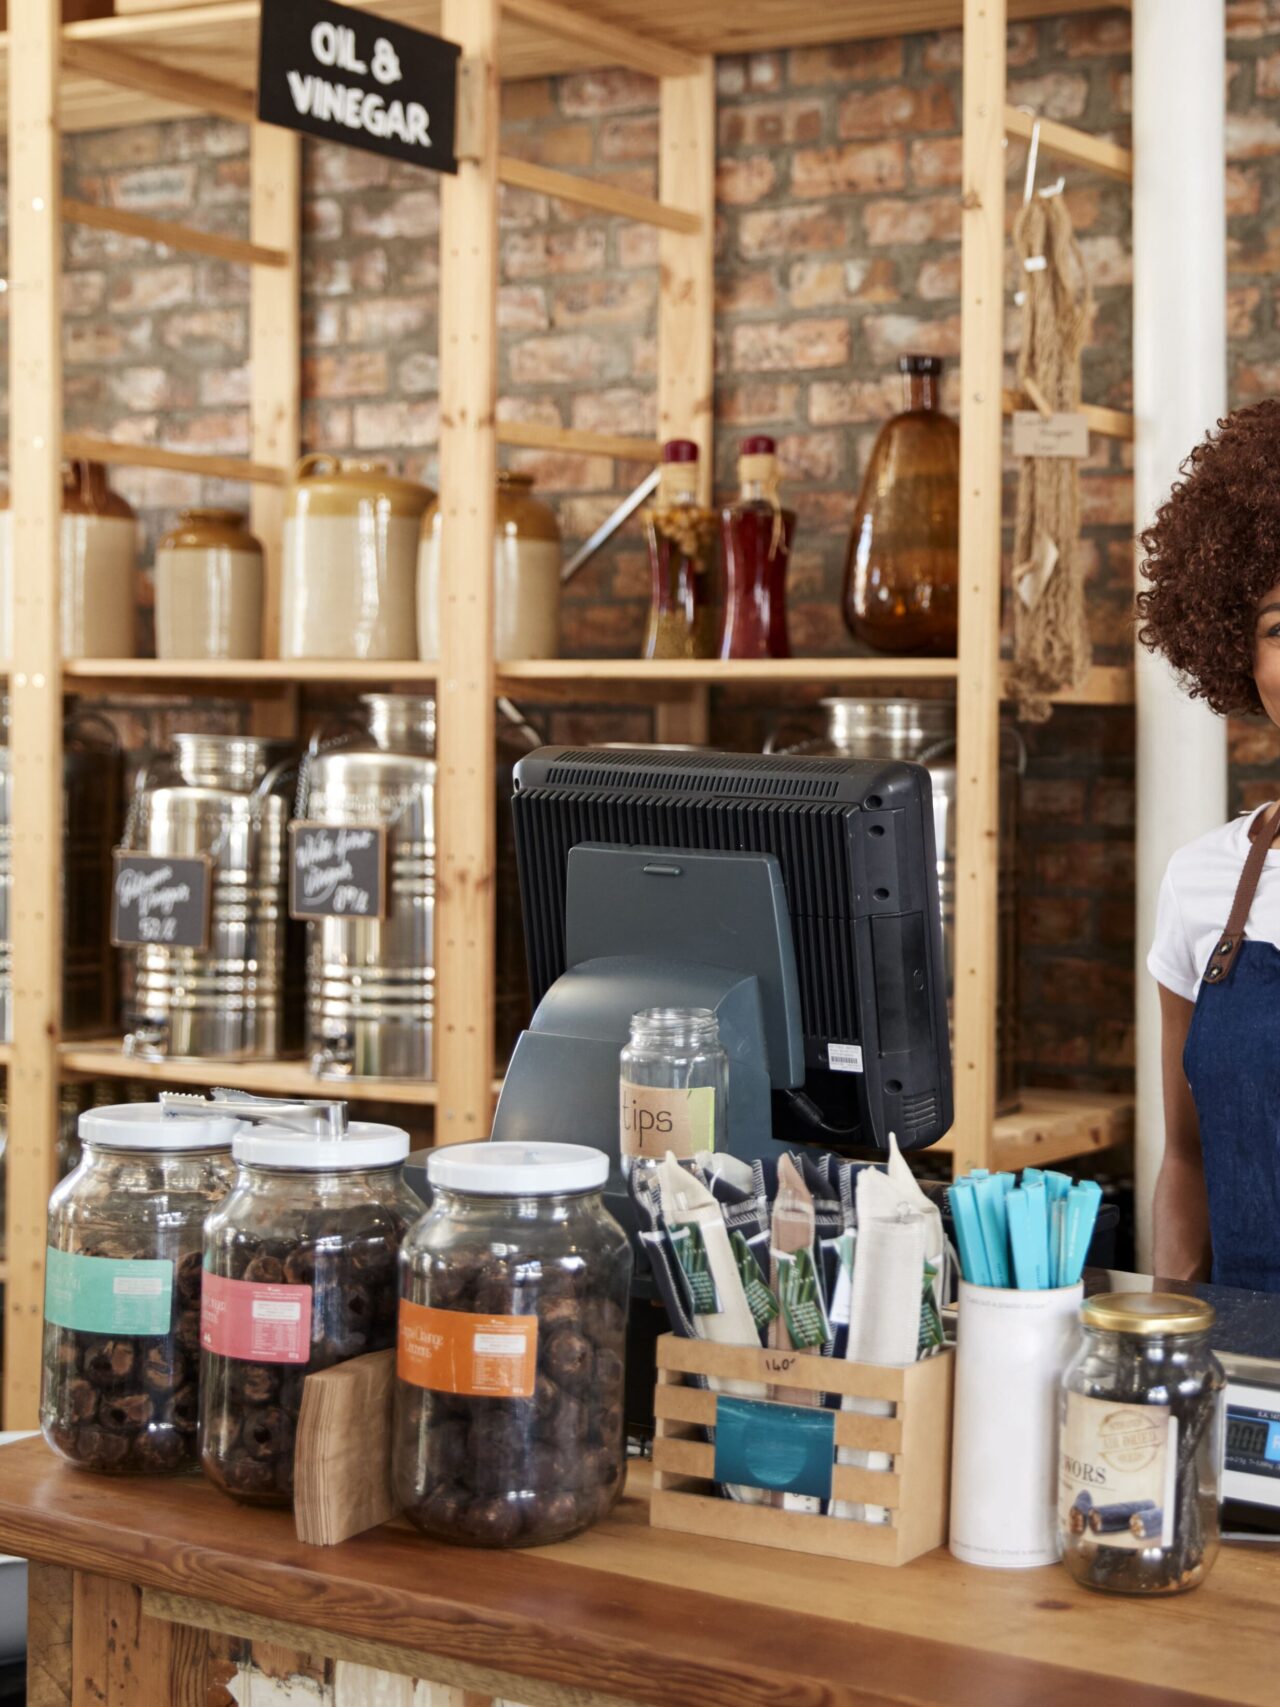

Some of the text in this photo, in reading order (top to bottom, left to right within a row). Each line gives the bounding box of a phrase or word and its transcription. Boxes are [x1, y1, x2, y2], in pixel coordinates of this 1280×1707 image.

[311, 21, 402, 84] OIL &
[286, 70, 432, 147] VINEGAR
[622, 1089, 673, 1148] tips
